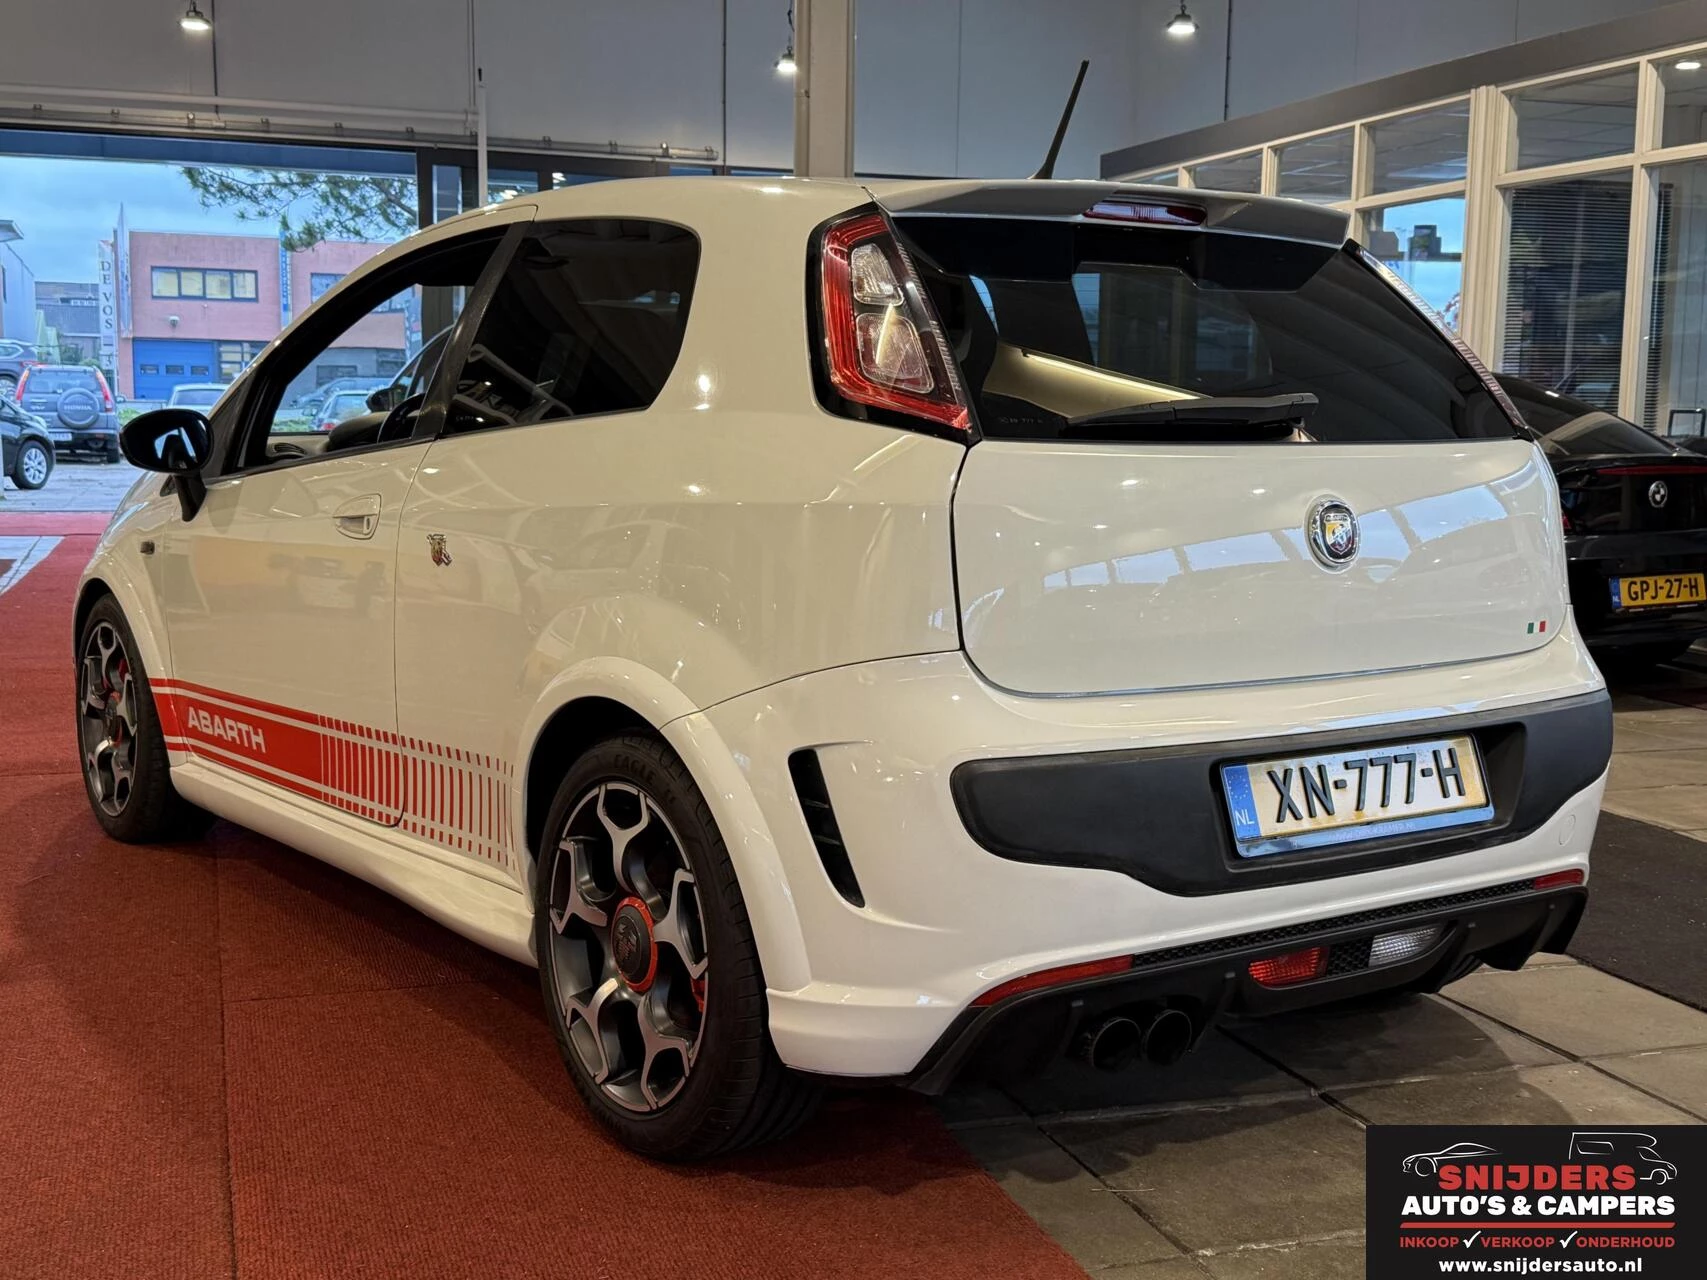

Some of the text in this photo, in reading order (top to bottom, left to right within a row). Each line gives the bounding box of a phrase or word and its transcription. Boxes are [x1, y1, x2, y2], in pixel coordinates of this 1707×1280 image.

[101, 260, 114, 330] DE VOS
[1627, 577, 1700, 602] GPJ-27-H
[187, 706, 267, 753] ABARTH
[1267, 747, 1466, 824] XN-777-H
[1234, 809, 1255, 826] NL
